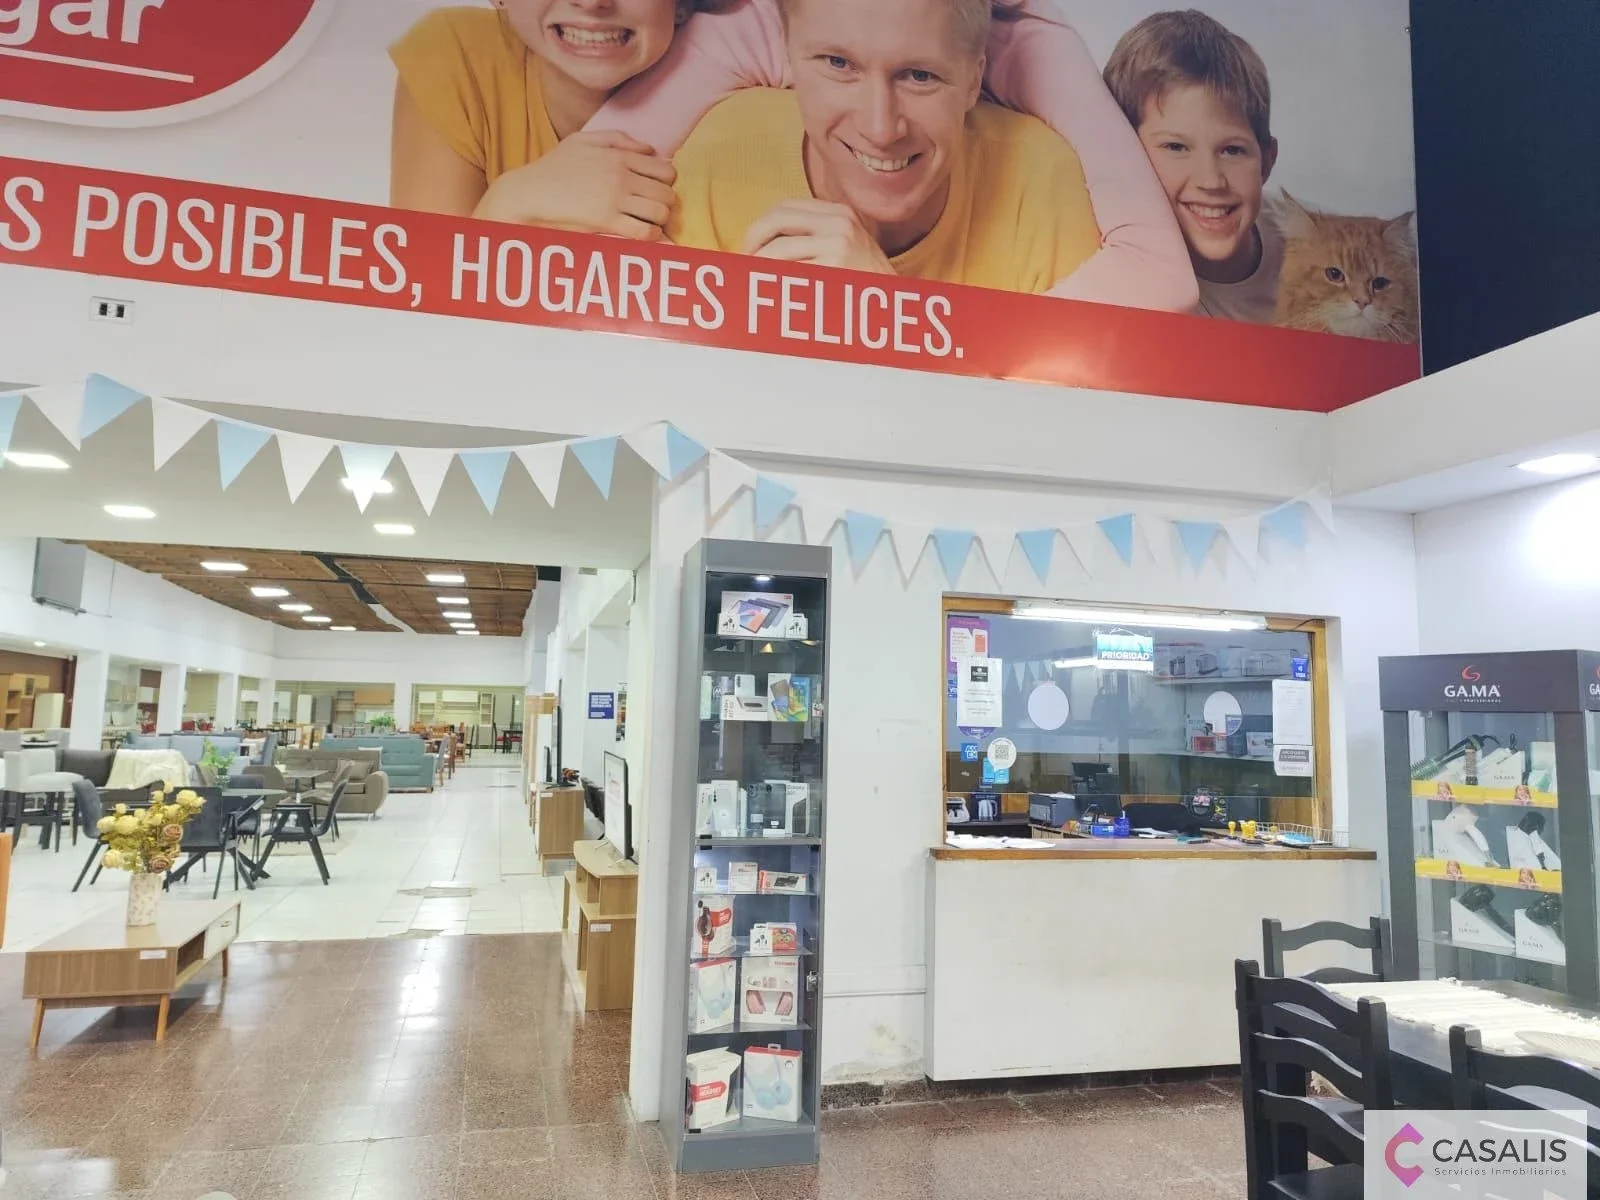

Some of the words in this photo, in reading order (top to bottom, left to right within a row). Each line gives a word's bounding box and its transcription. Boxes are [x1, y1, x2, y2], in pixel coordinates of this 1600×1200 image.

[72, 184, 422, 308] POSIBLES,
[451, 232, 725, 330] HOGARES
[748, 271, 964, 359] FELICES.
[1101, 651, 1150, 661] PRIORIDAD
[1444, 684, 1502, 698] GA.MA
